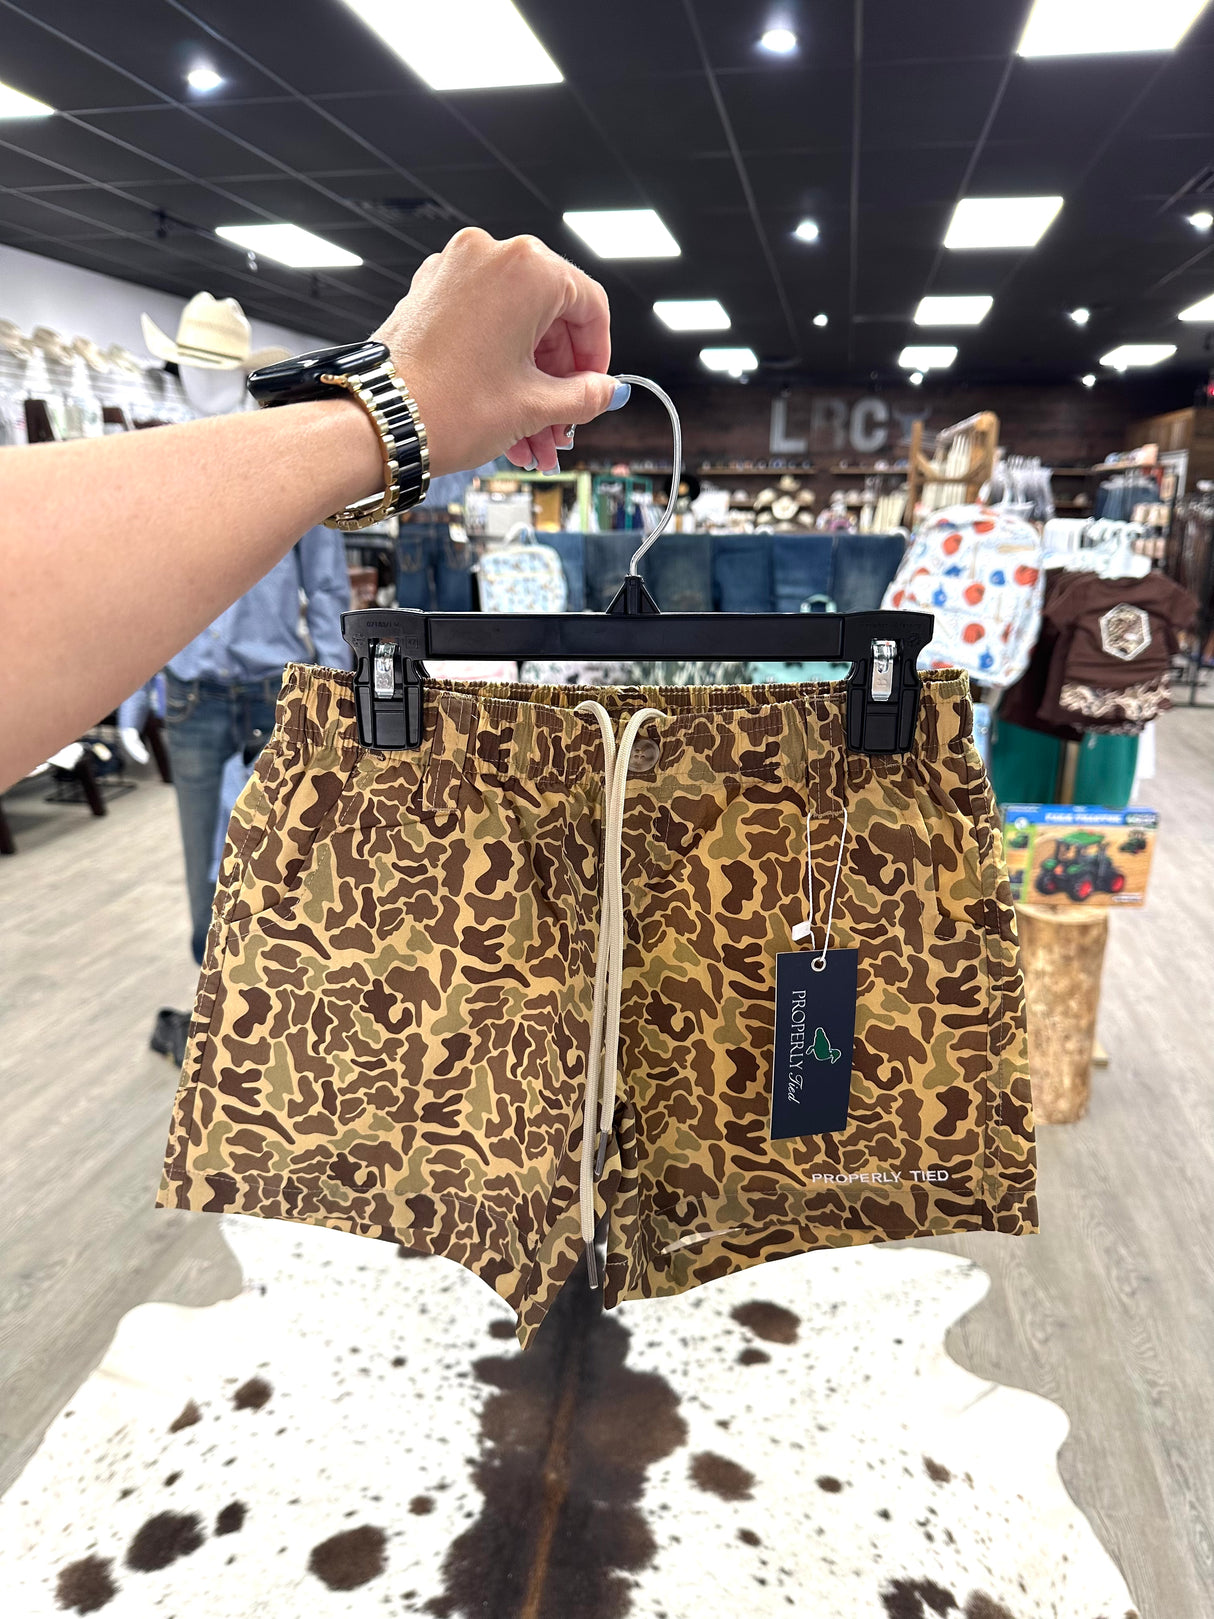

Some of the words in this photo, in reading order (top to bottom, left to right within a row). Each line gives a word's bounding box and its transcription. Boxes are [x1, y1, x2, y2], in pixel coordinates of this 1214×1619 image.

[771, 399, 888, 453] LRC
[789, 990, 806, 1070] PROPERLY
[787, 1072, 803, 1104] Tied
[811, 1171, 902, 1184] PROPERLY
[909, 1170, 950, 1182] TIED
